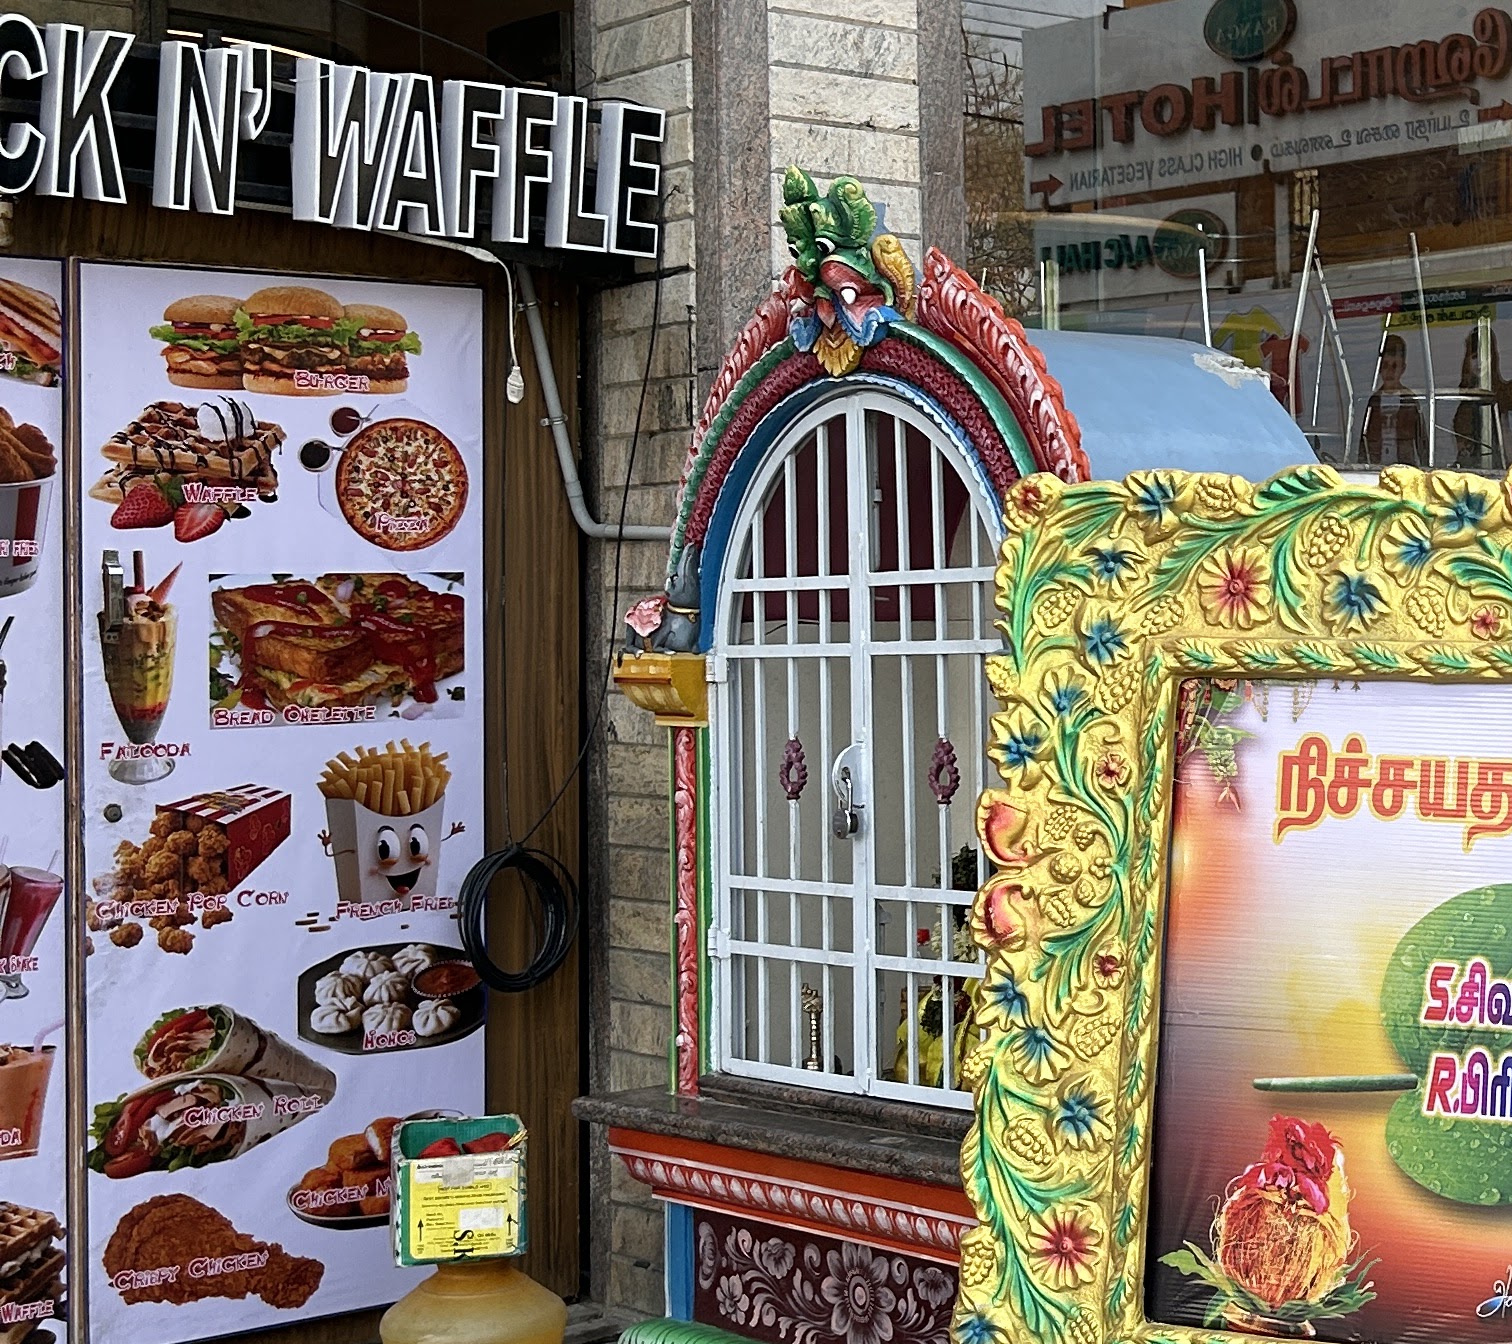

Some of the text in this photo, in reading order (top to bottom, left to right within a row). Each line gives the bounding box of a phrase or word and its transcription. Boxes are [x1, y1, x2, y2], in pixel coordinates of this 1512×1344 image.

[292, 56, 665, 258] WAFFLE
[295, 370, 369, 391] BURGER
[181, 482, 257, 503] WAFFLE
[214, 708, 274, 727] BREAD
[100, 742, 191, 760] FALOODA
[187, 892, 227, 911] POP
[236, 889, 289, 907] CORN
[273, 1094, 324, 1116] ROLL
[1, 1299, 55, 1323] WAFFLE
